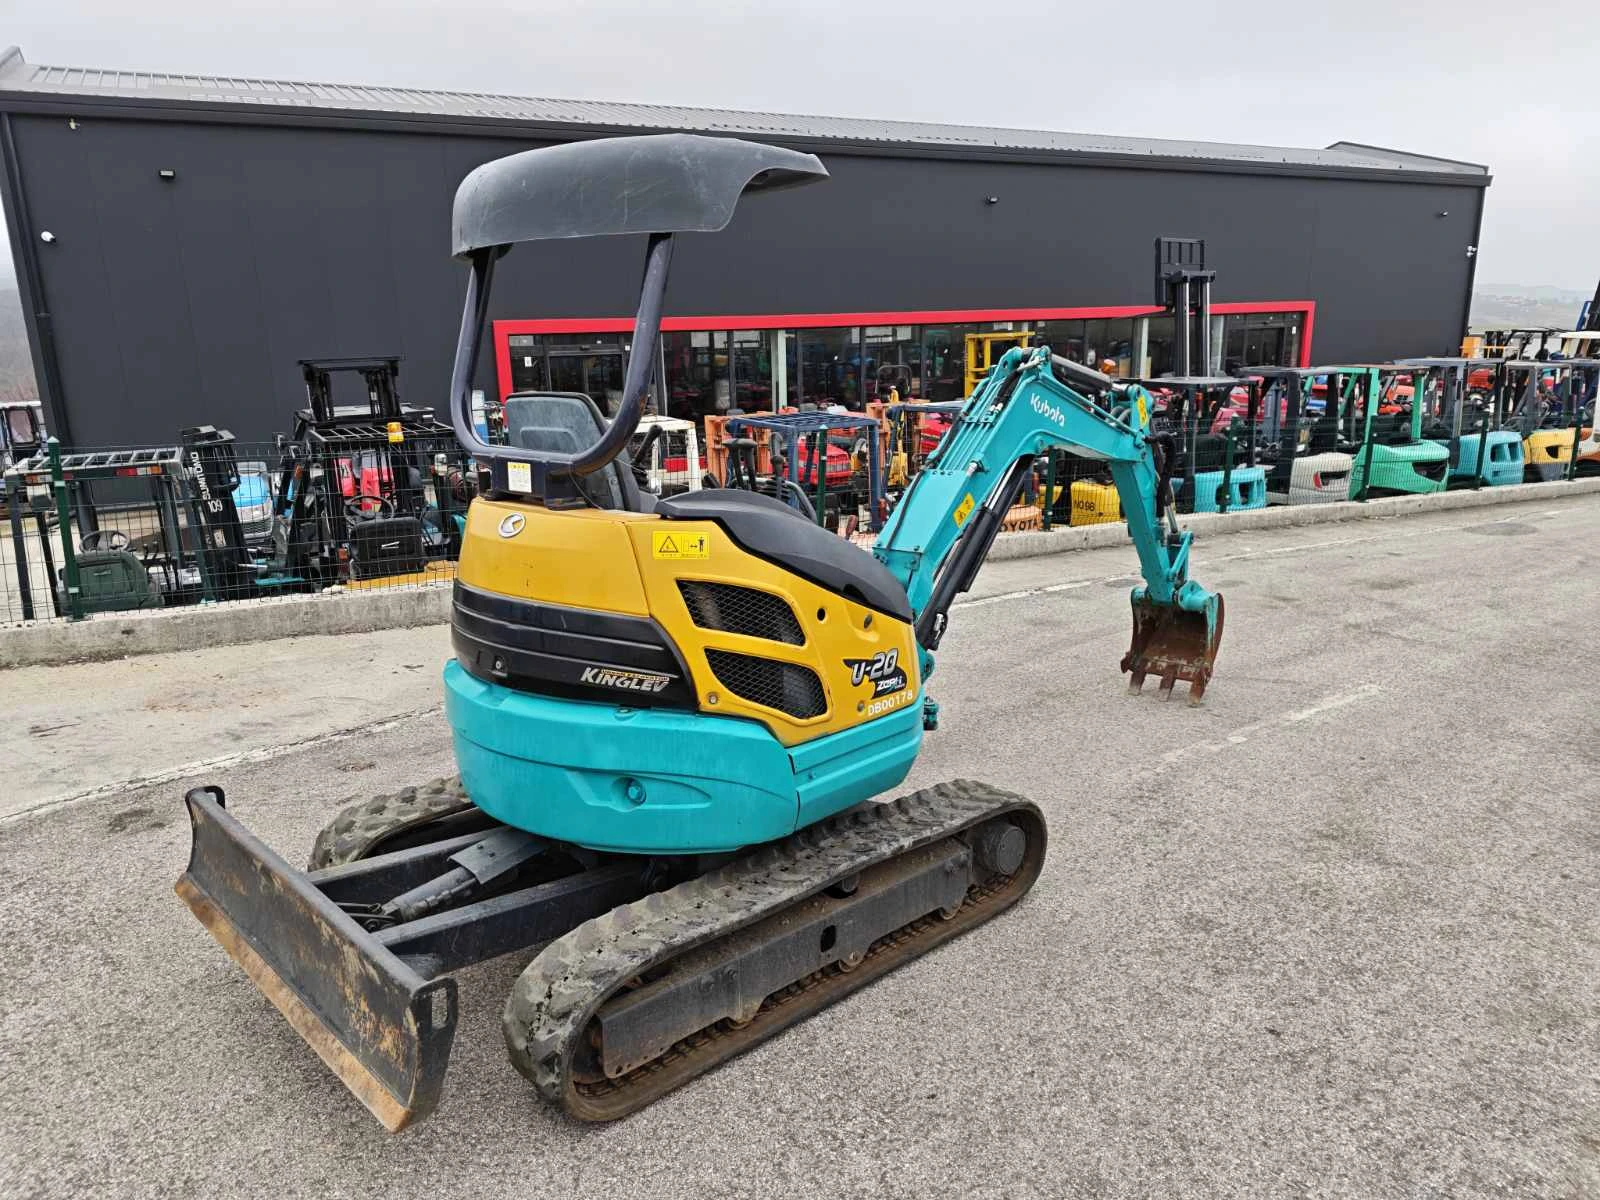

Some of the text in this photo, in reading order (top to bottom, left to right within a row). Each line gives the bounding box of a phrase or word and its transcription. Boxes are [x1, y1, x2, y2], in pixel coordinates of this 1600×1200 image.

[1030, 392, 1065, 427] Kubota
[190, 452, 211, 500] SUMITOMO
[208, 499, 223, 513] 109
[1001, 520, 1038, 533] OYOTA
[580, 666, 669, 693] KINGLEV
[851, 648, 898, 685] U-20
